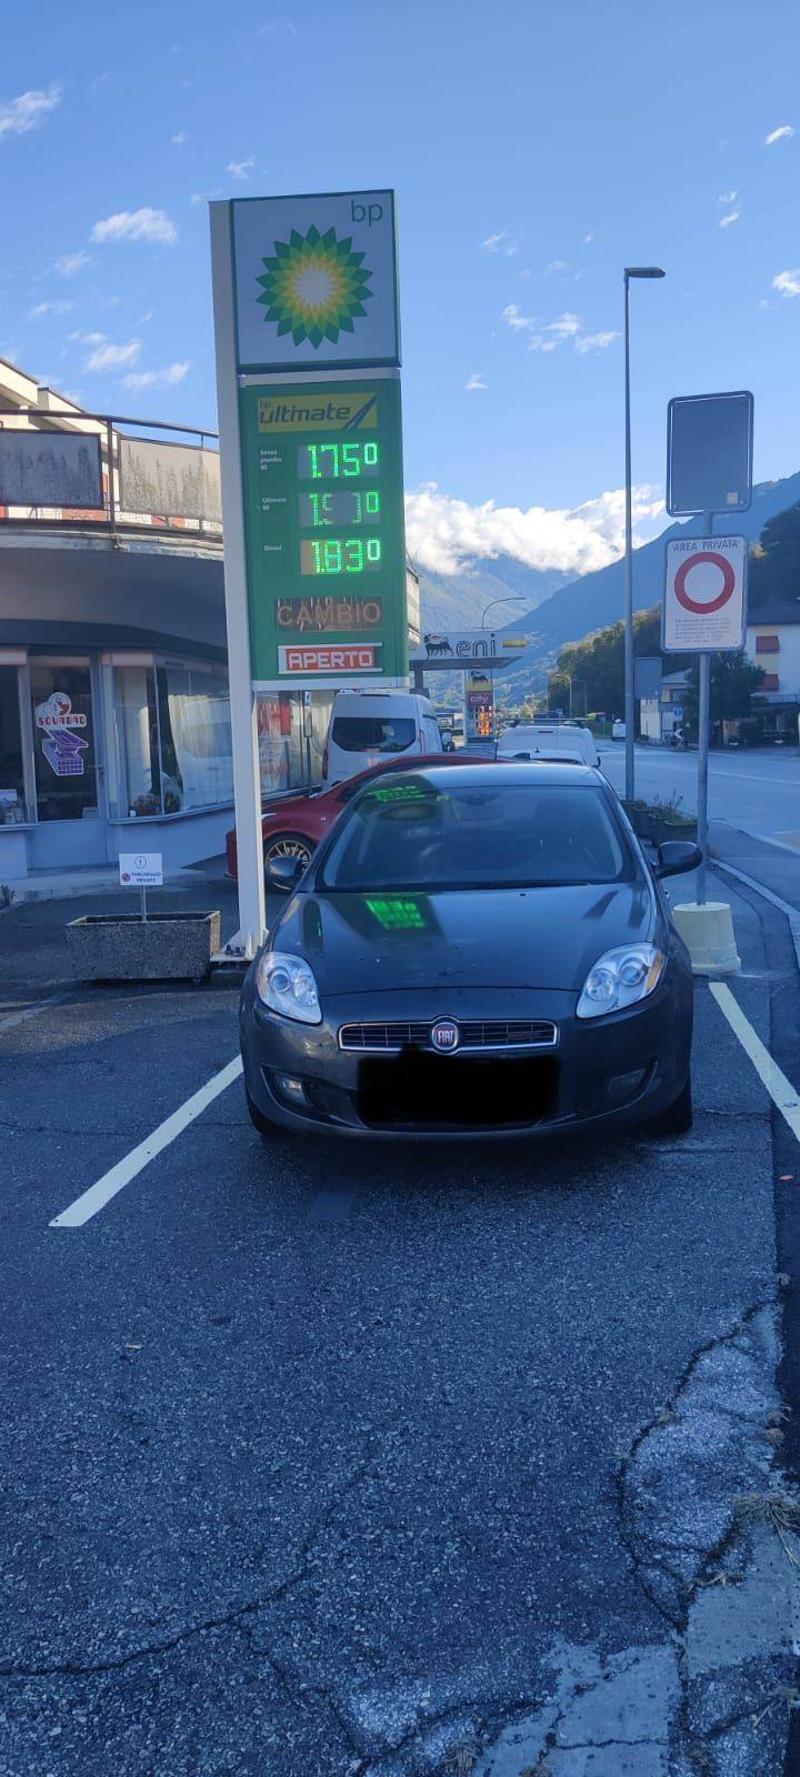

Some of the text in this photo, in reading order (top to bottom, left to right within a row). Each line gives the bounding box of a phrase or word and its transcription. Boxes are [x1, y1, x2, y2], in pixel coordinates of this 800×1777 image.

[351, 199, 383, 227] bp
[260, 403, 351, 424] ultimate
[277, 602, 381, 626] CAMBIO
[455, 633, 497, 657] eni
[288, 650, 373, 669] APERTO
[437, 1030, 454, 1044] FIAT
